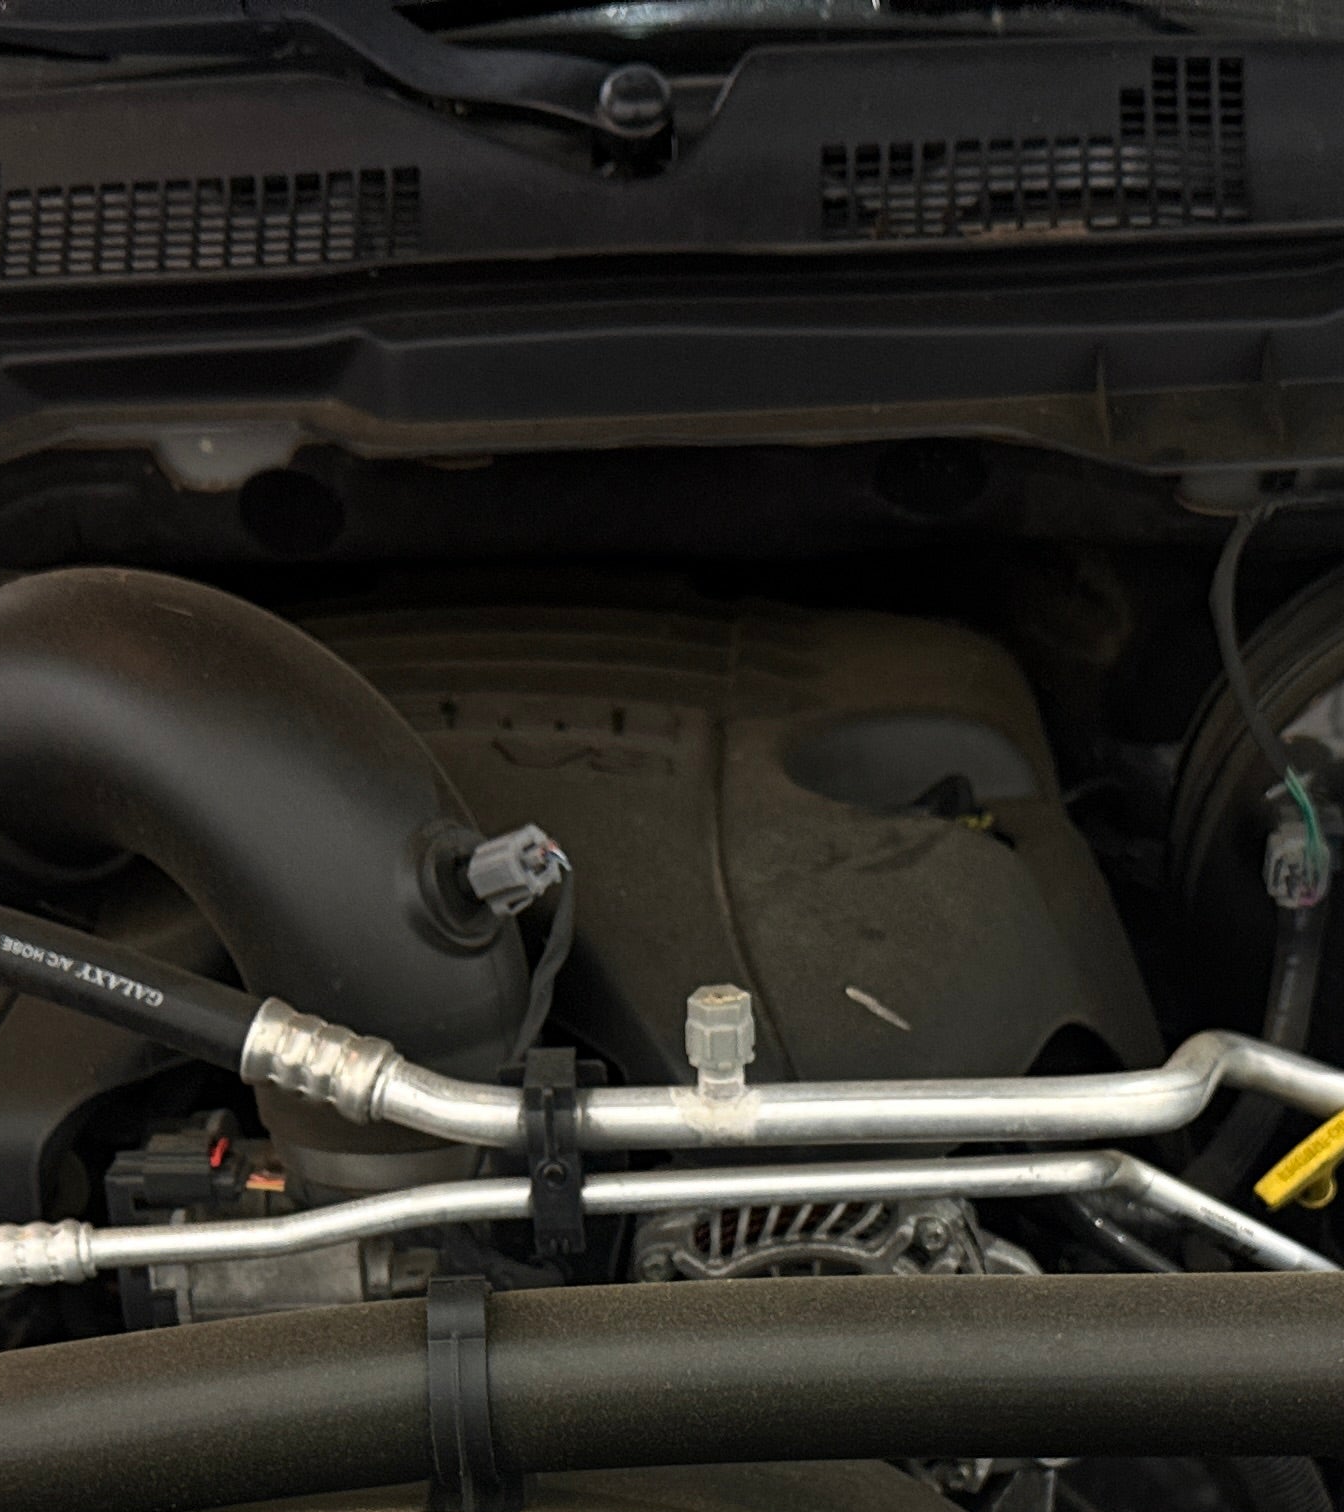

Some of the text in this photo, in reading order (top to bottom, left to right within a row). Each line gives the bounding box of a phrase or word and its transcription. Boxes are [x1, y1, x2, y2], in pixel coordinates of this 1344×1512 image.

[0, 935, 44, 963] HOSE
[45, 951, 74, 972] A/C
[75, 963, 164, 1007] GALAXY
